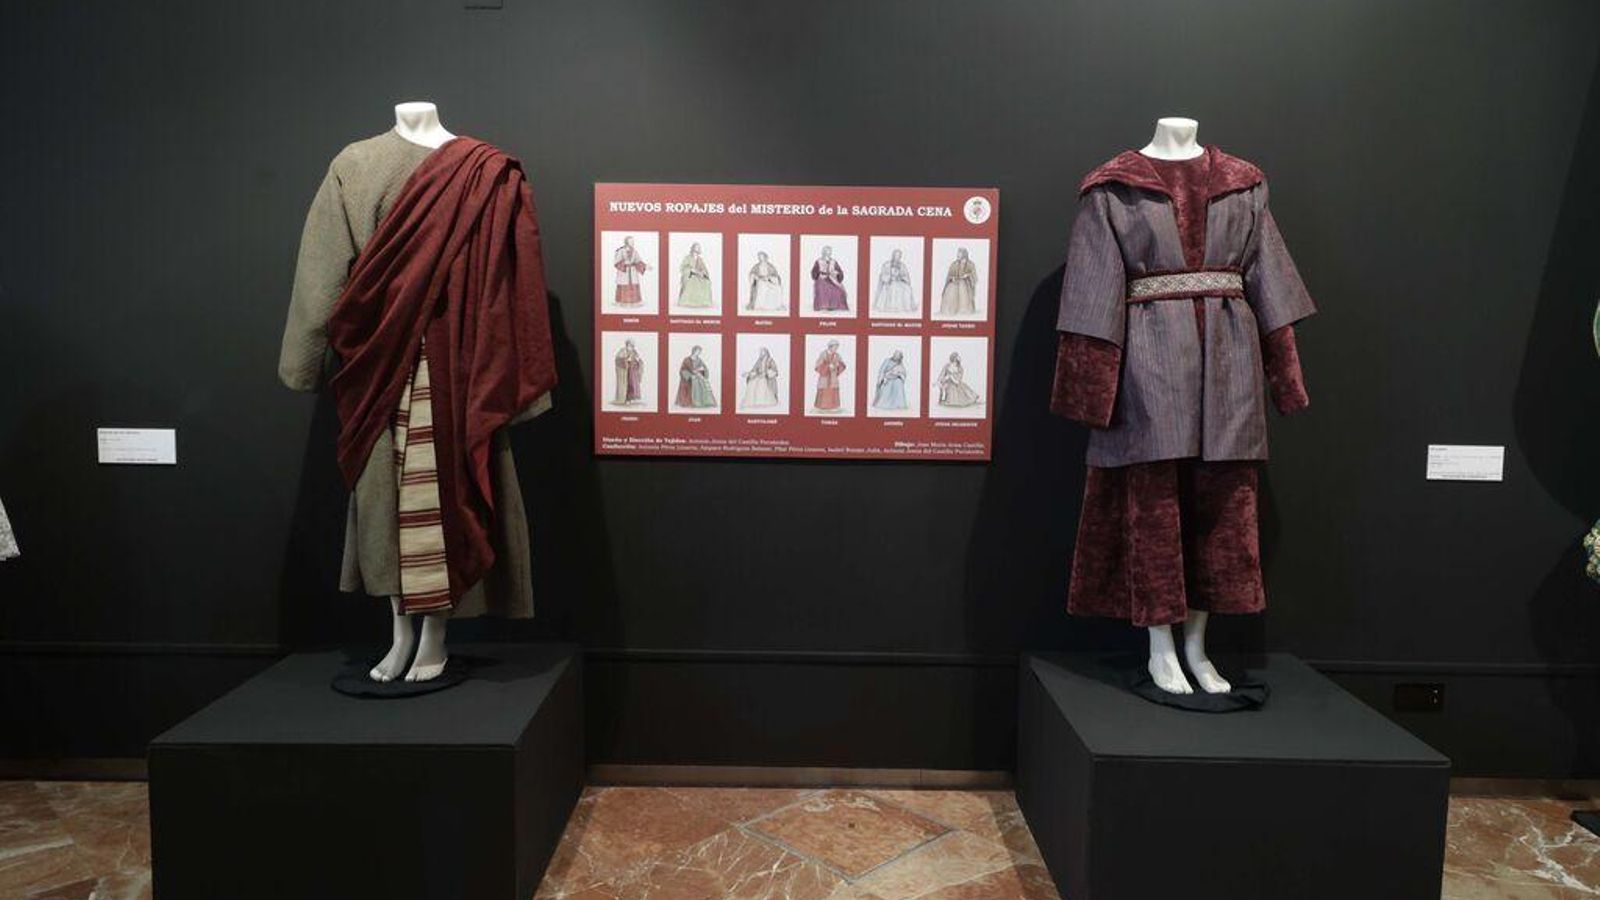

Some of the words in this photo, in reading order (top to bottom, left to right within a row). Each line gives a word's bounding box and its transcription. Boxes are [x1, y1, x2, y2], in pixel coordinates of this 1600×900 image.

[609, 201, 662, 212] NUEVOS
[665, 202, 725, 214] ROPAJES
[728, 203, 747, 213] del
[750, 204, 815, 215] MISTERIO
[818, 204, 833, 215] de
[837, 204, 849, 215] la
[852, 205, 914, 217] SAGRADA
[917, 206, 953, 217] CENA
